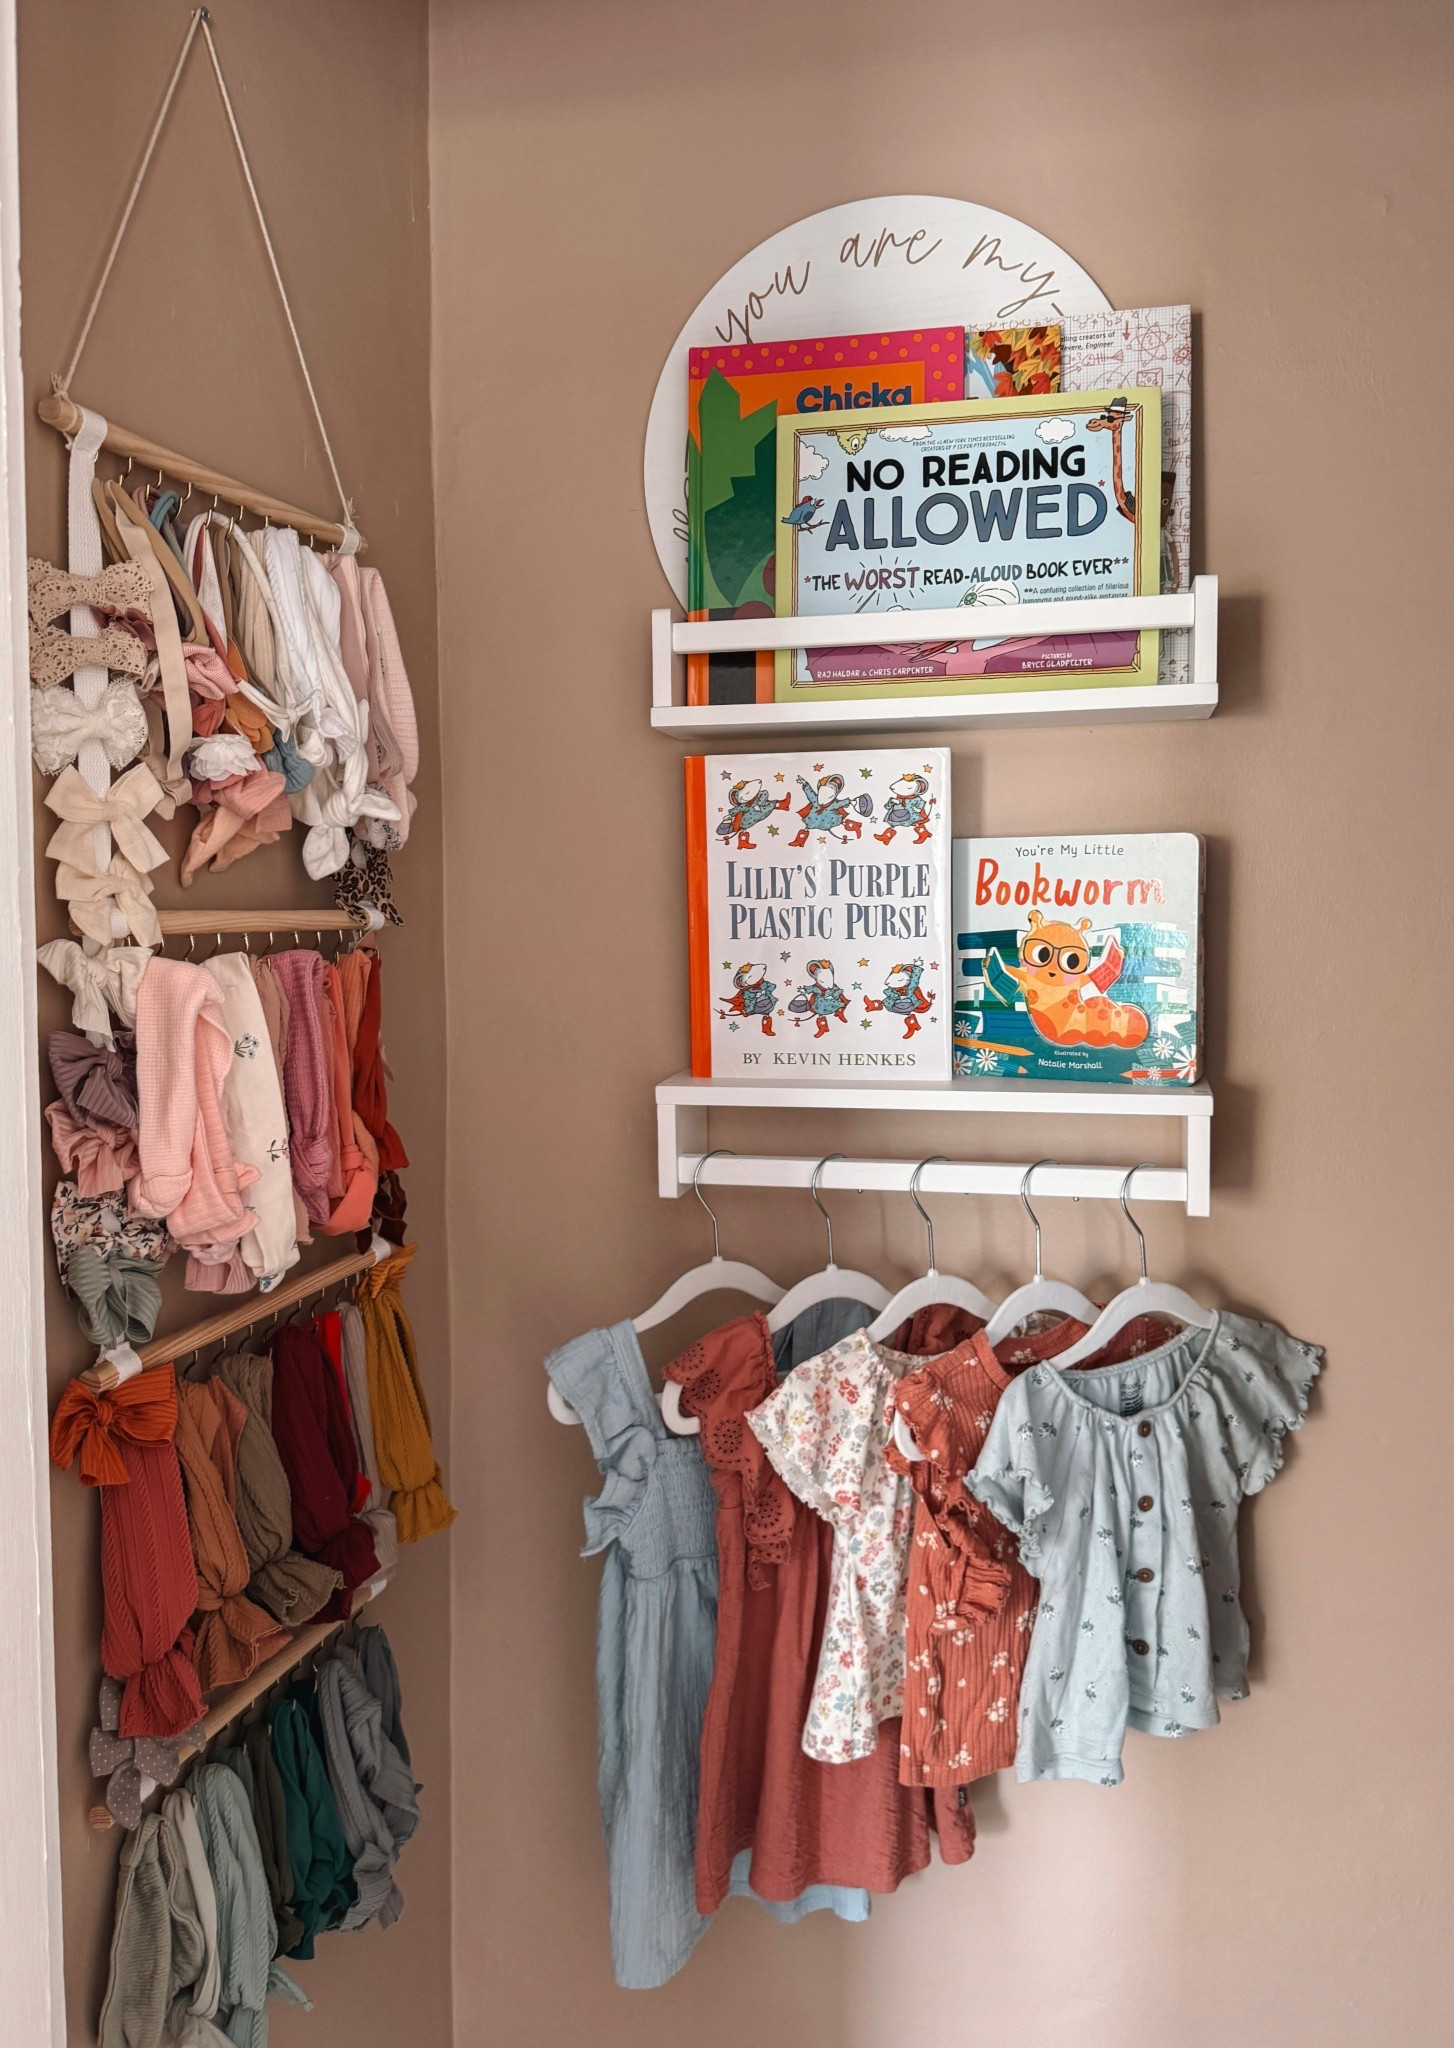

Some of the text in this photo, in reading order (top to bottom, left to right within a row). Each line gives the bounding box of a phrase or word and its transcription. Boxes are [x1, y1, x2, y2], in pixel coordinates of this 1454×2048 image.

[715, 227, 1061, 344] you are my
[1078, 333, 1106, 341] creators
[1085, 341, 1114, 350] Engineer
[796, 382, 911, 413] Chicka
[847, 445, 1086, 493] NO READING
[844, 566, 920, 591] WORST
[923, 564, 1022, 586] READ-ALOUD
[1026, 560, 1068, 580] BOOK
[1039, 586, 1067, 595] confusing
[1068, 583, 1096, 593] collection
[1105, 582, 1129, 590] hilarious
[1065, 593, 1097, 601] sound-alike
[1021, 658, 1093, 669] BRYCE GLADFELTER
[817, 671, 831, 679] RAJ
[832, 669, 860, 678] HALDAR
[868, 668, 891, 677] CHRIS
[892, 666, 934, 676] CARPENTER
[1015, 844, 1124, 858] You're My Little
[725, 859, 930, 900] LILLY'S PURPLE
[975, 858, 1168, 907] Bookworm
[729, 902, 928, 941] PLASTIC PURSE
[742, 1052, 917, 1066] BY KEVIN HENKES
[1038, 1058, 1103, 1070] Natalie Marshall
